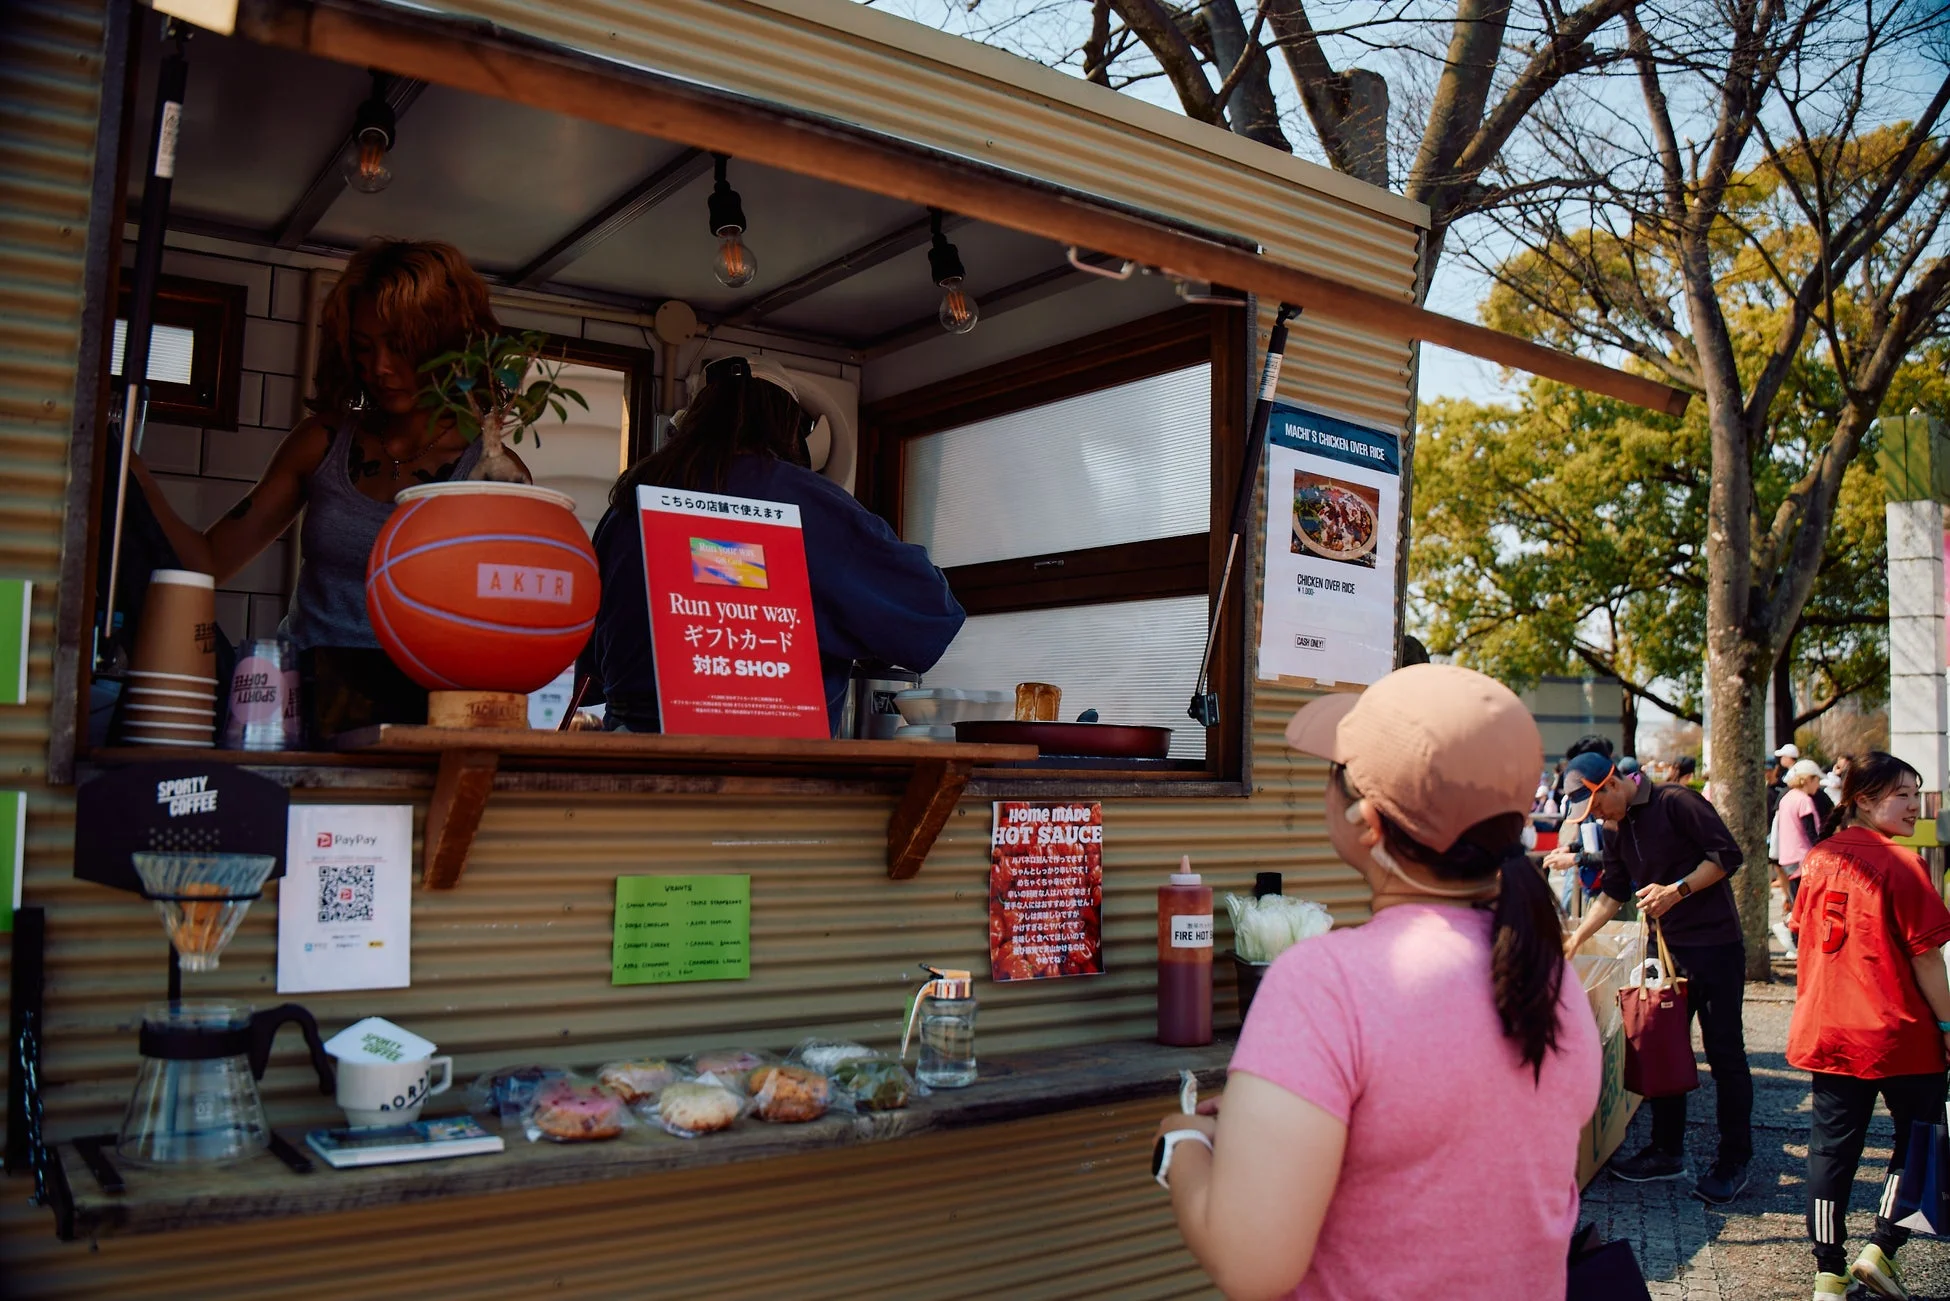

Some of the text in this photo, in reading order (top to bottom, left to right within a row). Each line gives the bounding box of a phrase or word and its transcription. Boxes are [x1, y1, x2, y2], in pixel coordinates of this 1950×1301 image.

[1319, 432, 1348, 451] CHICKEN
[1350, 440, 1368, 456] OVER
[1369, 445, 1385, 460] RICE
[661, 495, 784, 520] こちらの店舗で使えます
[490, 568, 564, 596] AKTR
[1297, 573, 1355, 594] CHICKEN OVER RICE
[669, 592, 801, 629] Run your way.
[684, 624, 793, 653] ギフトカード
[1296, 637, 1324, 649] CASH ONLY!
[692, 654, 791, 678] 対応 SHOP
[235, 673, 269, 688] COFFEE
[236, 689, 276, 704] SPORTY
[158, 775, 208, 797] SPORTY
[170, 793, 217, 817] COFFEE
[334, 834, 377, 846] PayPay
[992, 825, 1103, 845] HOT SAUCE
[1822, 890, 1848, 954] 5
[1174, 931, 1193, 941] FIRE
[1195, 931, 1209, 940] HOT
